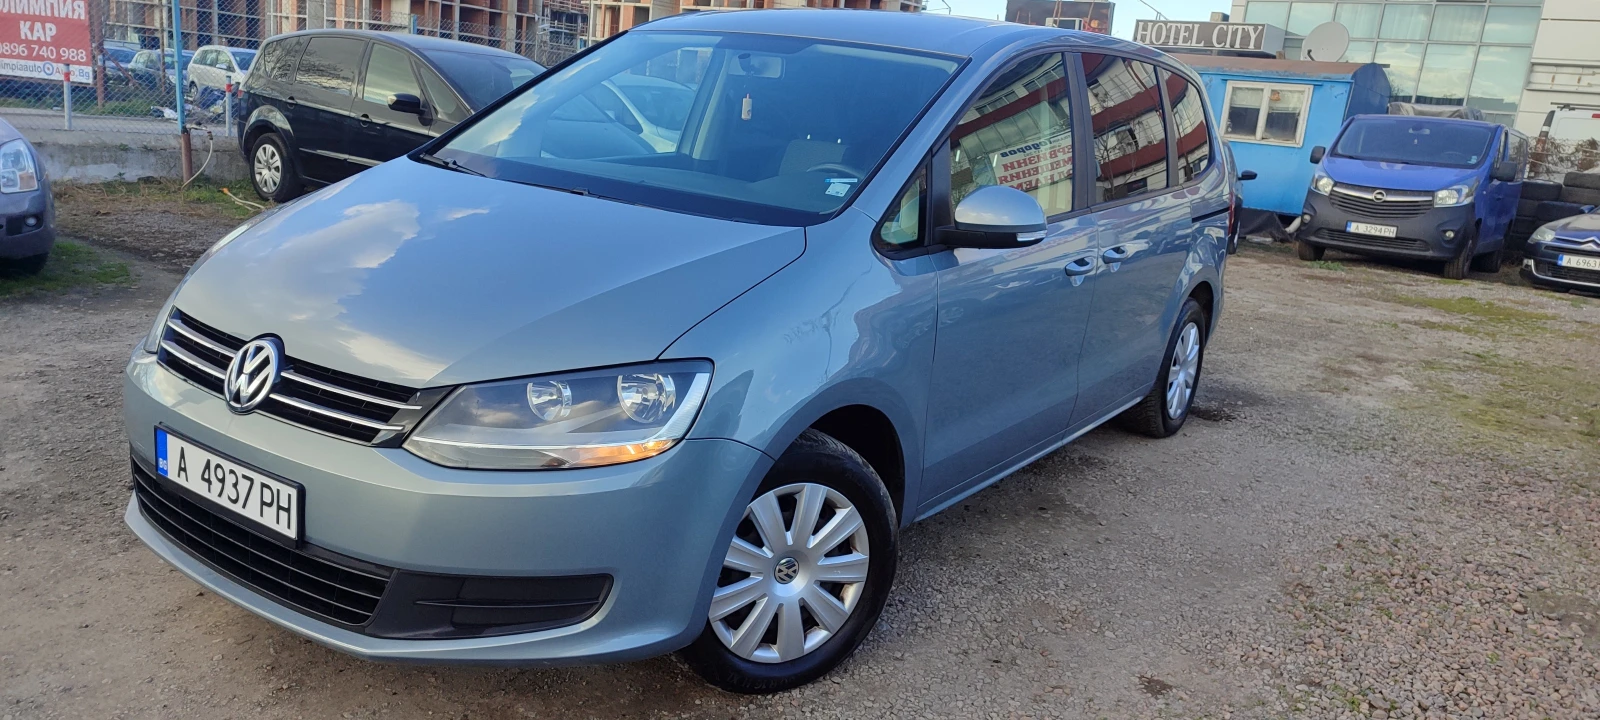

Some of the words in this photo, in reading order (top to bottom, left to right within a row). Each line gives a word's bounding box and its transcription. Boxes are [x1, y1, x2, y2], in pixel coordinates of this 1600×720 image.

[19, 20, 57, 42] КАР
[1136, 21, 1204, 47] HOTEL
[1212, 24, 1263, 49] CITY
[31, 44, 57, 59] 740
[60, 47, 87, 62] 988
[177, 446, 189, 482] A
[200, 458, 254, 509] 4937
[259, 481, 292, 530] PH
